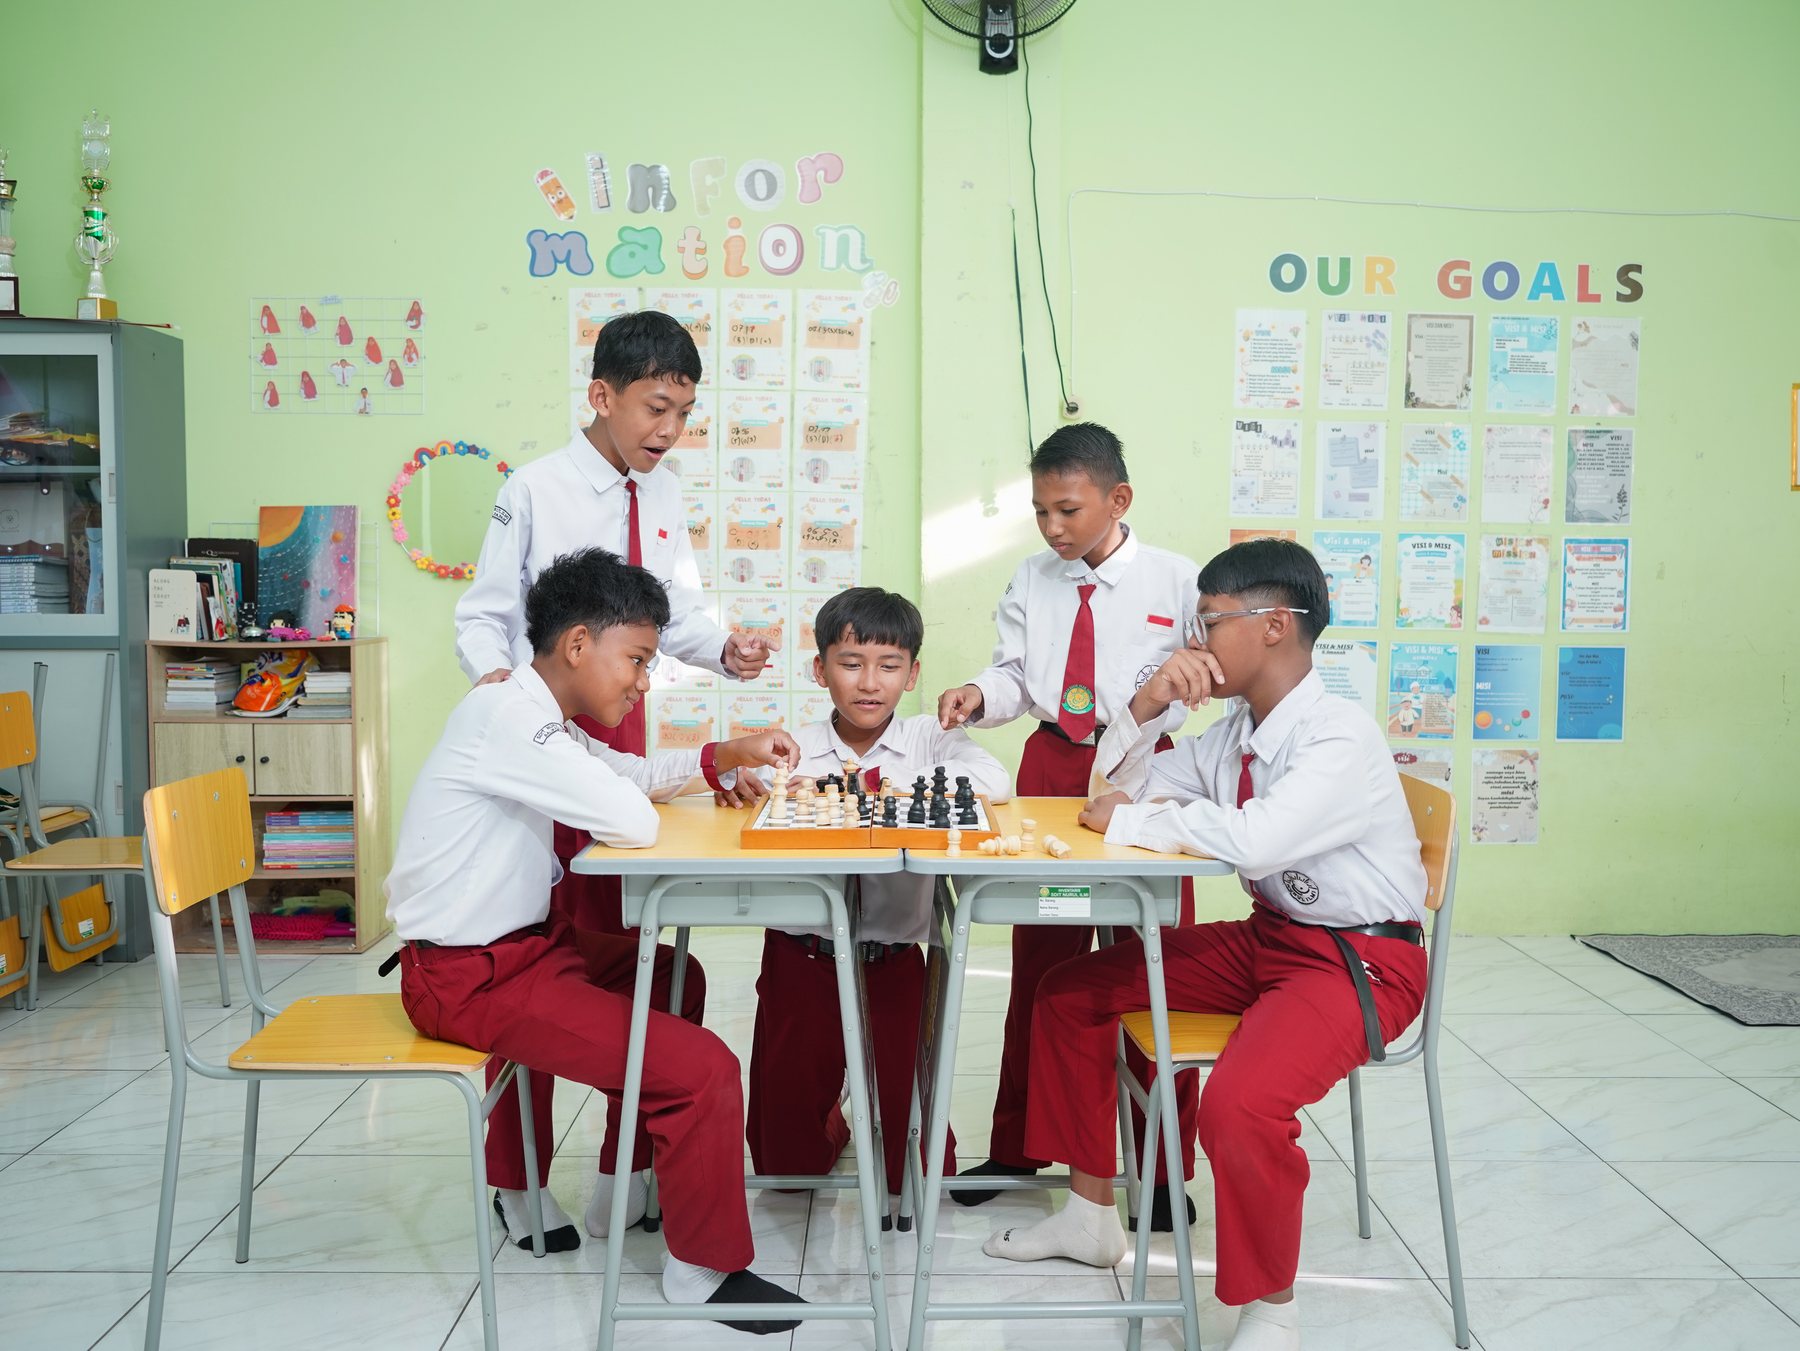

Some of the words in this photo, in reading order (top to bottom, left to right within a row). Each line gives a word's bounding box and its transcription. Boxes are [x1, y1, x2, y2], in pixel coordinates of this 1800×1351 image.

[1269, 253, 1396, 296] OUR
[1437, 258, 1644, 304] GOALS
[1476, 682, 1491, 690] MISI
